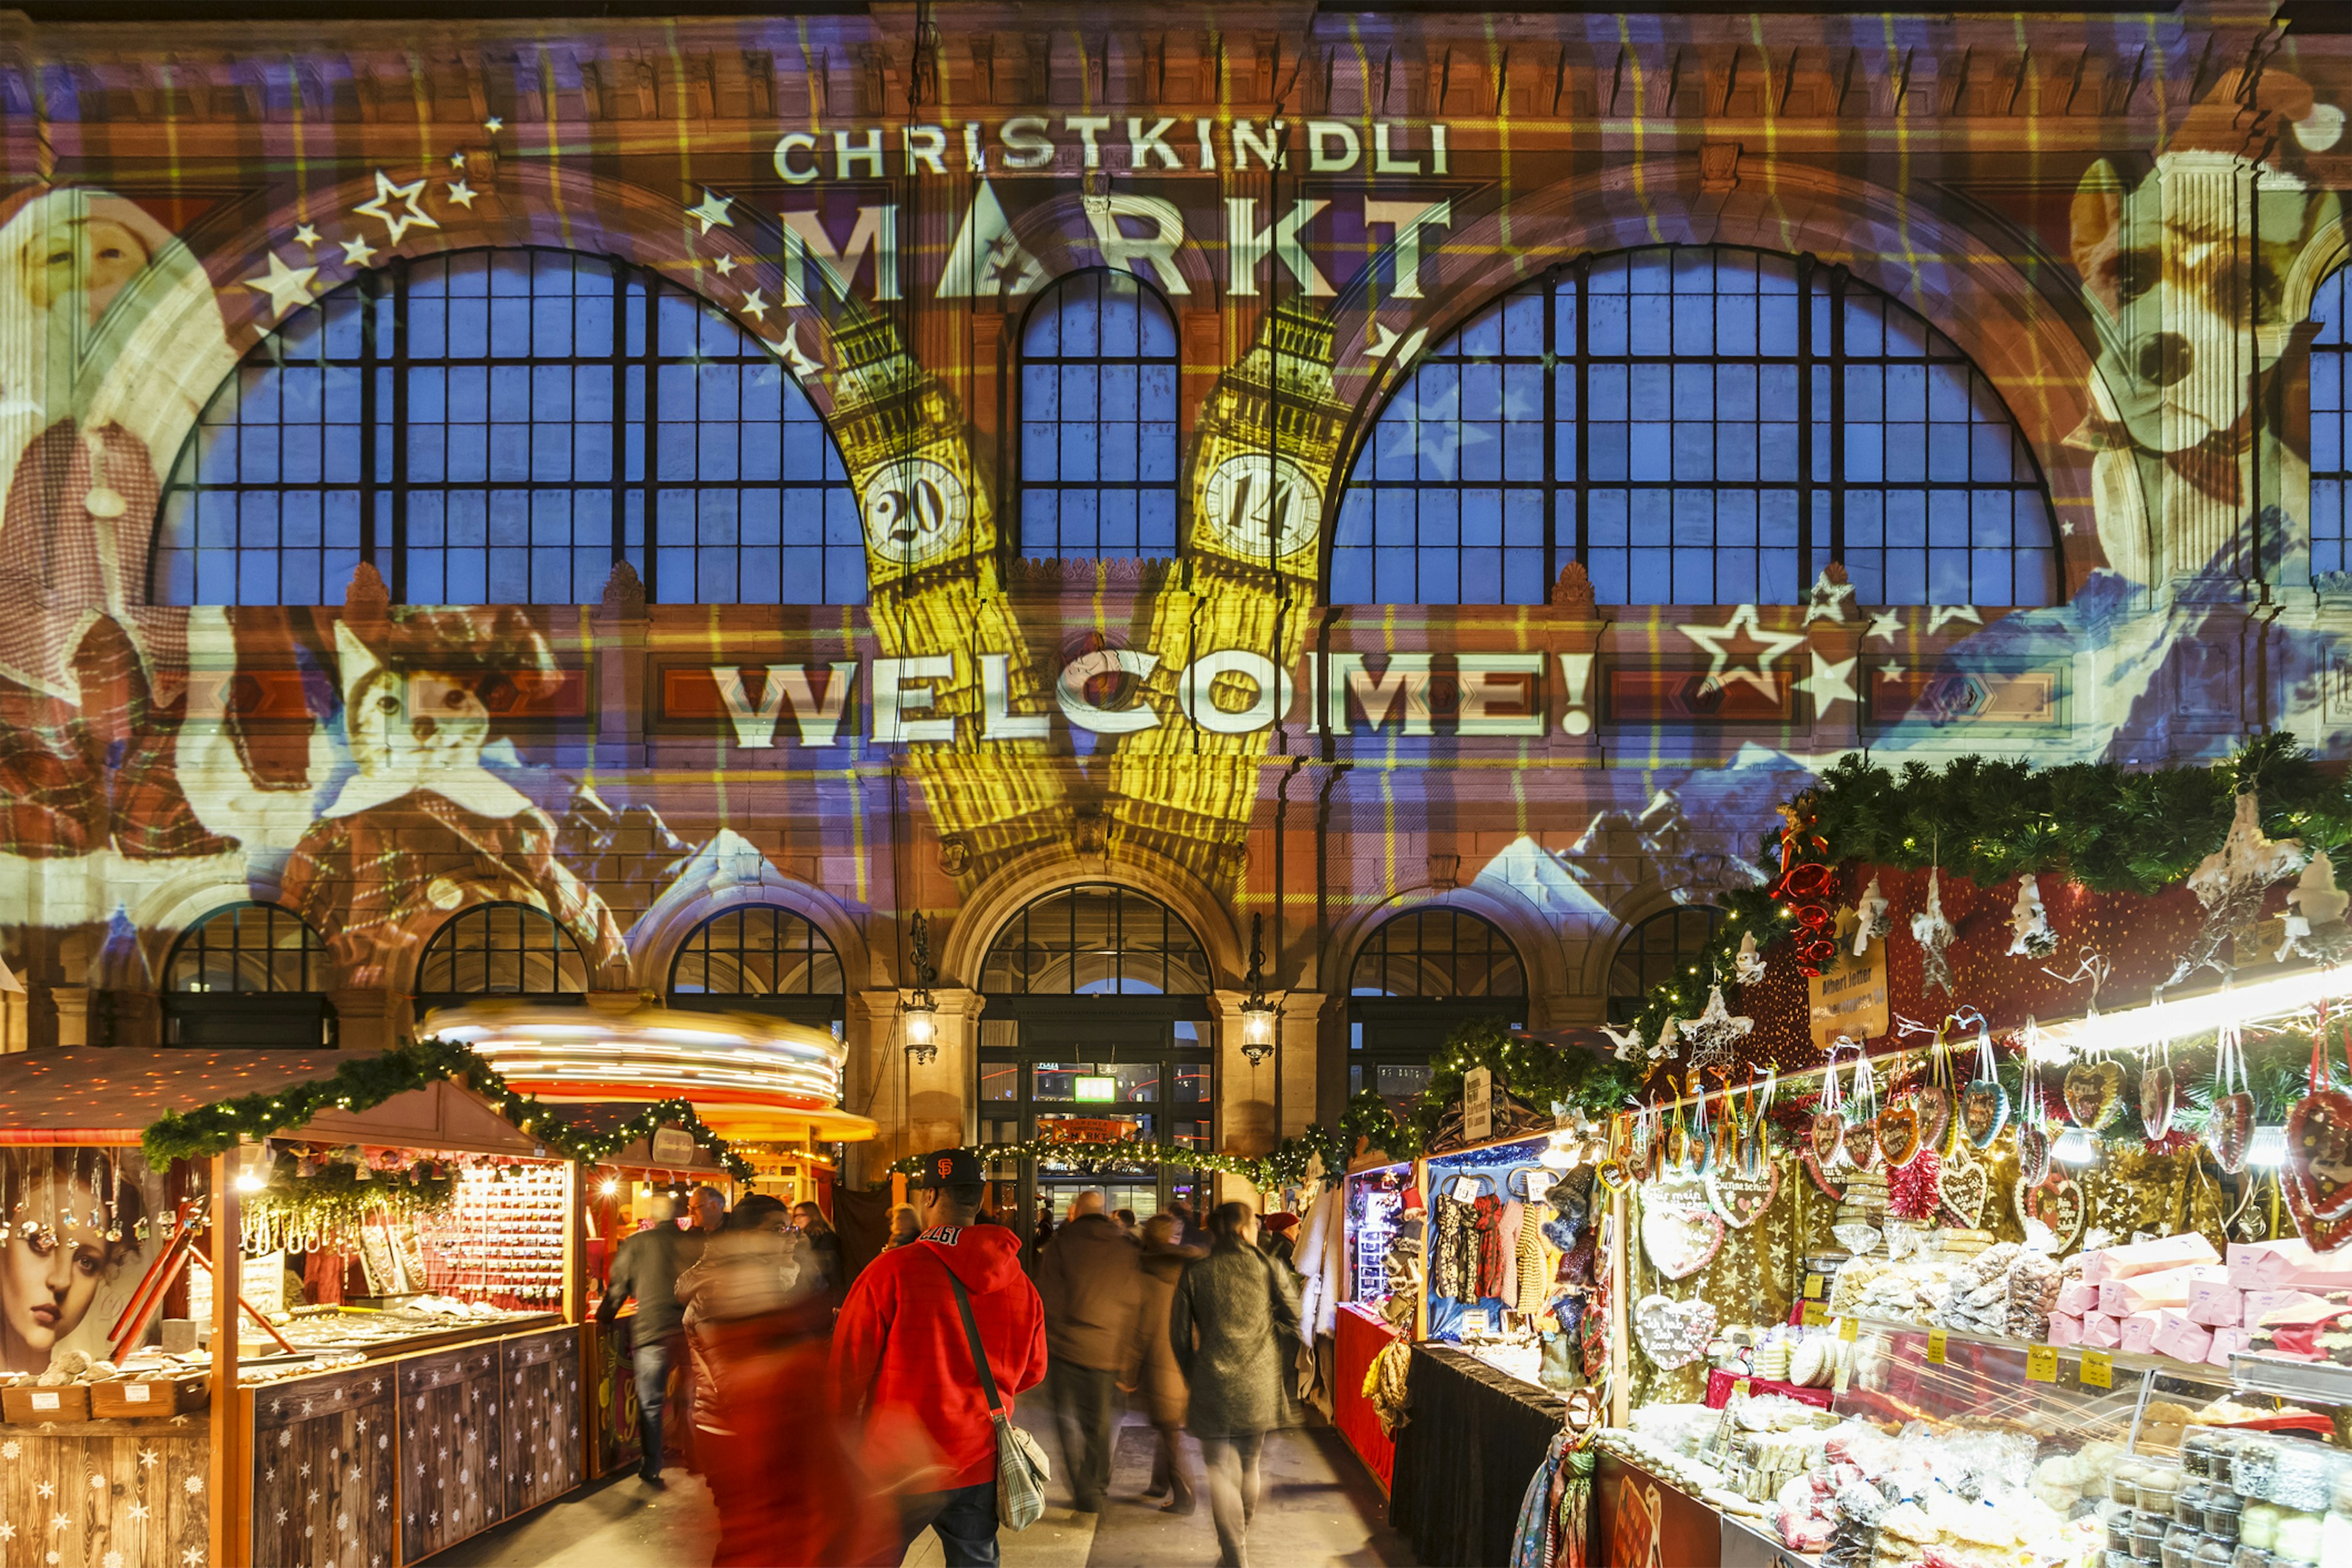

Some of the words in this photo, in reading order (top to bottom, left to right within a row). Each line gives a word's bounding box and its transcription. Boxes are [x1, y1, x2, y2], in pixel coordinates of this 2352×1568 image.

[774, 115, 1450, 185] CHRISTKINDLI
[782, 180, 1452, 309] MARKT
[876, 480, 950, 542] 20
[1224, 469, 1292, 537] 14
[712, 650, 1594, 750] WELCOME!
[919, 1226, 963, 1246] 1977
